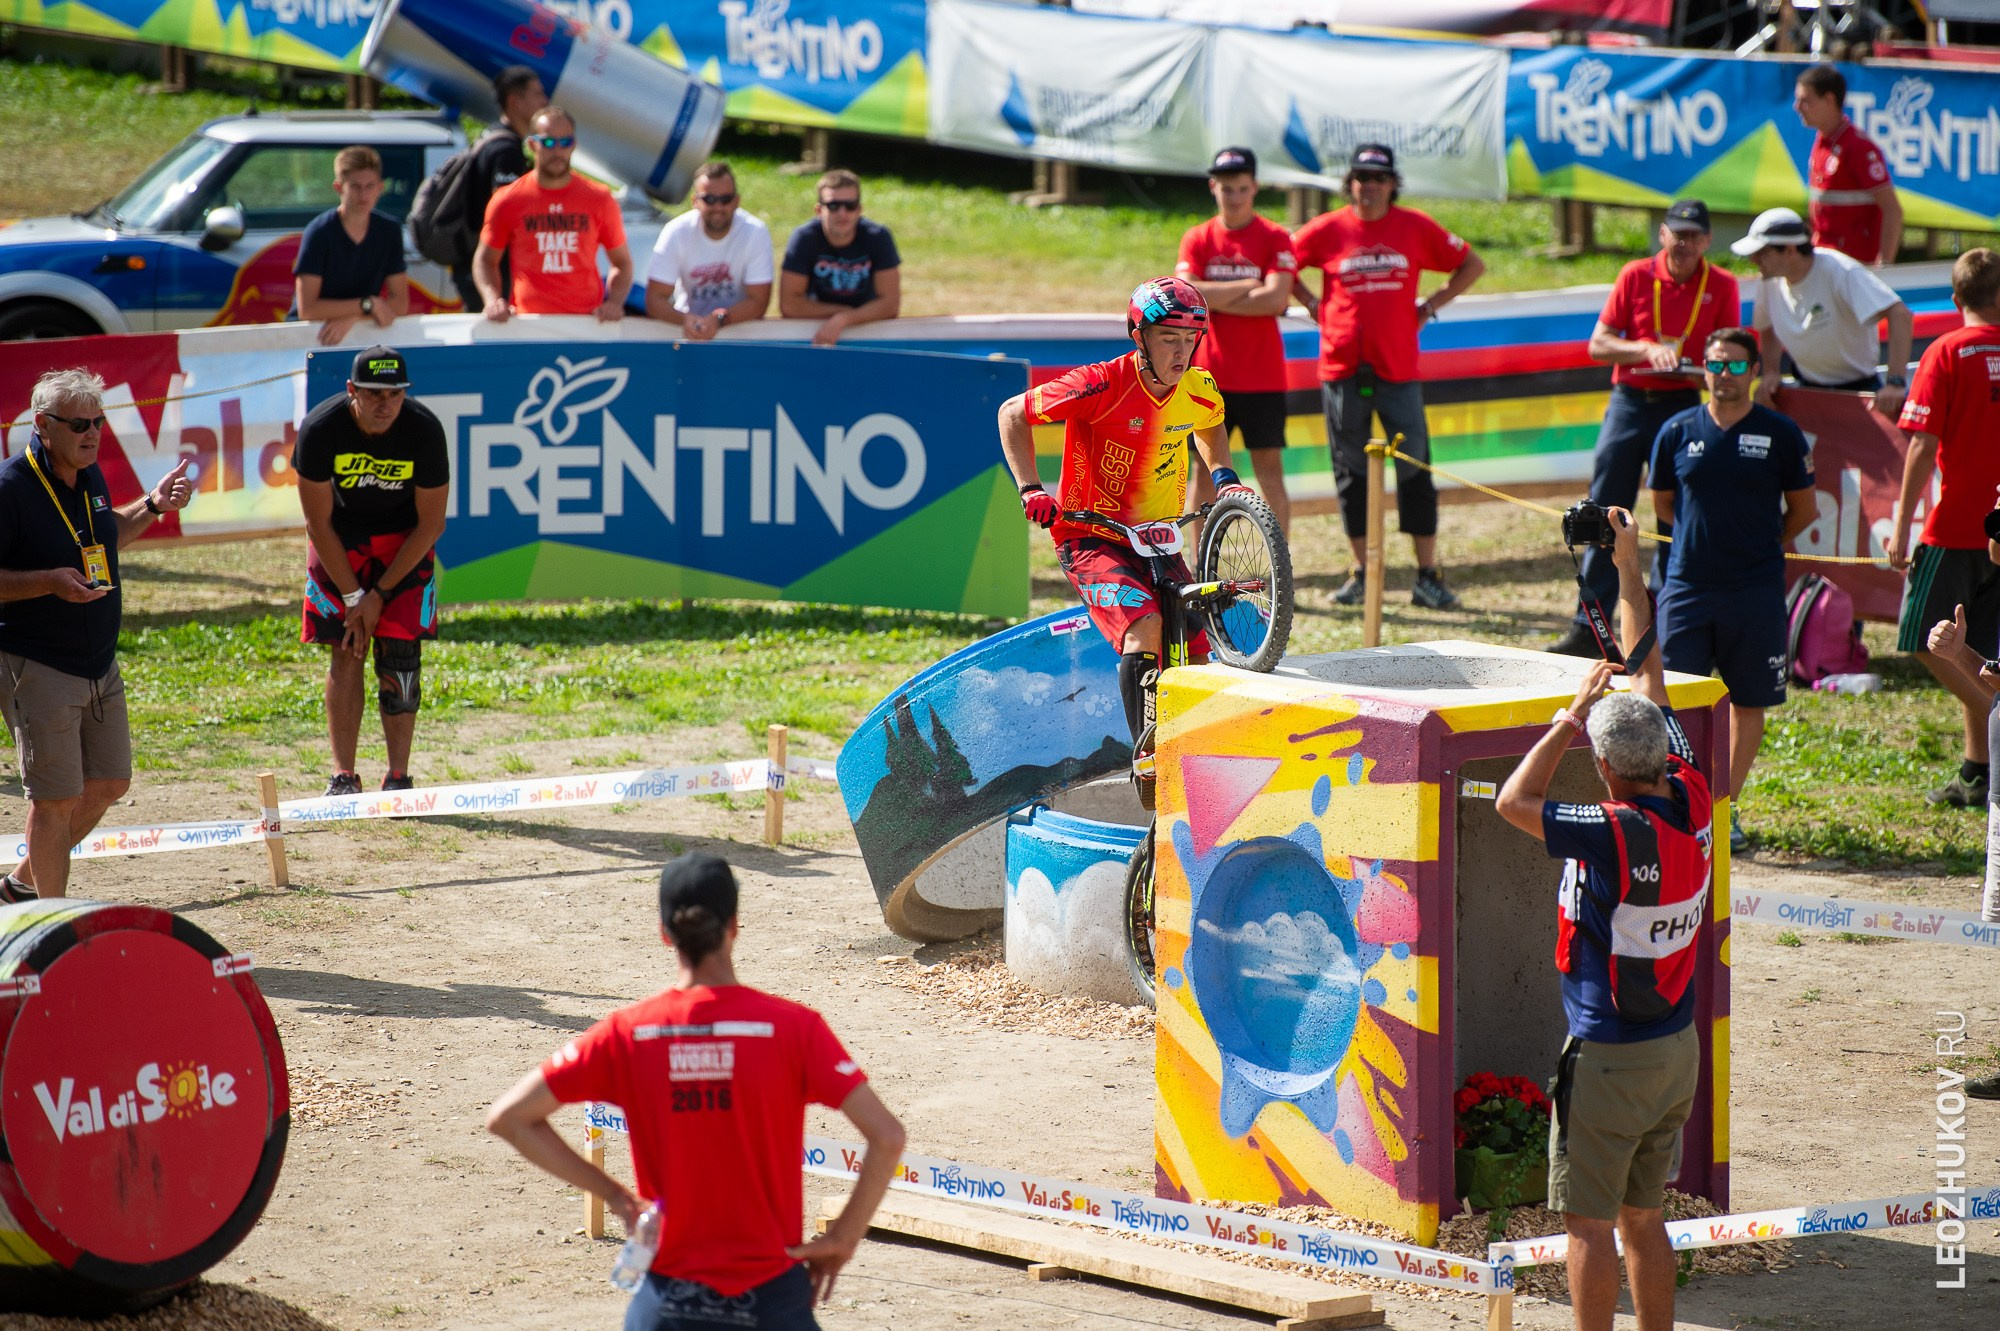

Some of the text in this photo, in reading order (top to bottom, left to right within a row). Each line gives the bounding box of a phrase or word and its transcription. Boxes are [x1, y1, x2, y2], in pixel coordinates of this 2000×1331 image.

[718, 1, 883, 84] TRENTINO
[1528, 73, 1728, 161] TRENTINO
[523, 213, 590, 231] WINNER
[535, 231, 579, 253] TAKE
[542, 251, 574, 273] ALL
[259, 420, 299, 488] d
[414, 393, 927, 537] TRENTINO
[1156, 469, 1177, 483] movistar
[1590, 608, 1609, 638] EOS 7D
[669, 1052, 735, 1071] WORLD
[32, 1062, 238, 1145] Val di Sole
[672, 1088, 732, 1112] 2016
[841, 1149, 864, 1174] Va
[929, 1166, 1005, 1199] TRENTINO
[1021, 1181, 1047, 1206] Val
[1049, 1196, 1061, 1210] di
[1111, 1199, 1189, 1233] TRENTINO
[1205, 1215, 1232, 1241] Val
[1234, 1230, 1246, 1244] di
[1298, 1234, 1378, 1270] TRENTINO
[1394, 1250, 1422, 1275] Val
[1425, 1266, 1437, 1278] di
[1796, 1211, 1869, 1234] TRENTINO
[1885, 1203, 1910, 1227] Val
[1910, 1211, 1922, 1224] di
